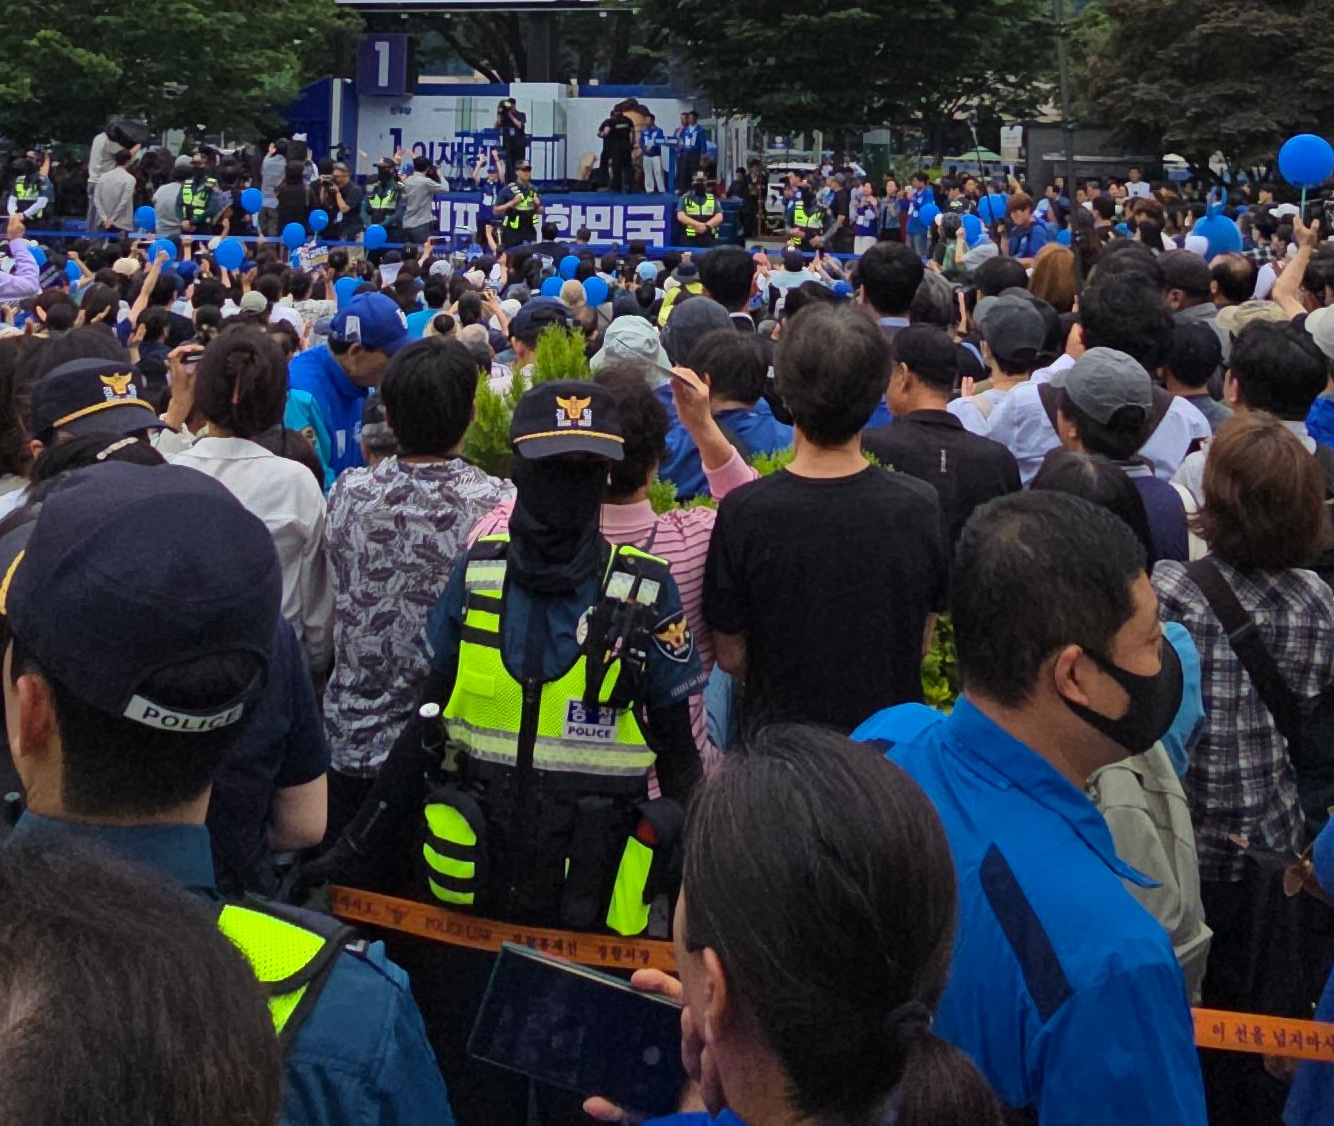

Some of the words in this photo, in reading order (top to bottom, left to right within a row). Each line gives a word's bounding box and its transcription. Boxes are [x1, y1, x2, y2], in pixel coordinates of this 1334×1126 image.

[374, 41, 390, 87] 1
[536, 203, 665, 247] 한민국
[143, 706, 242, 730] POLICE
[568, 726, 611, 739] POLICE
[1212, 1022, 1226, 1043] 이
